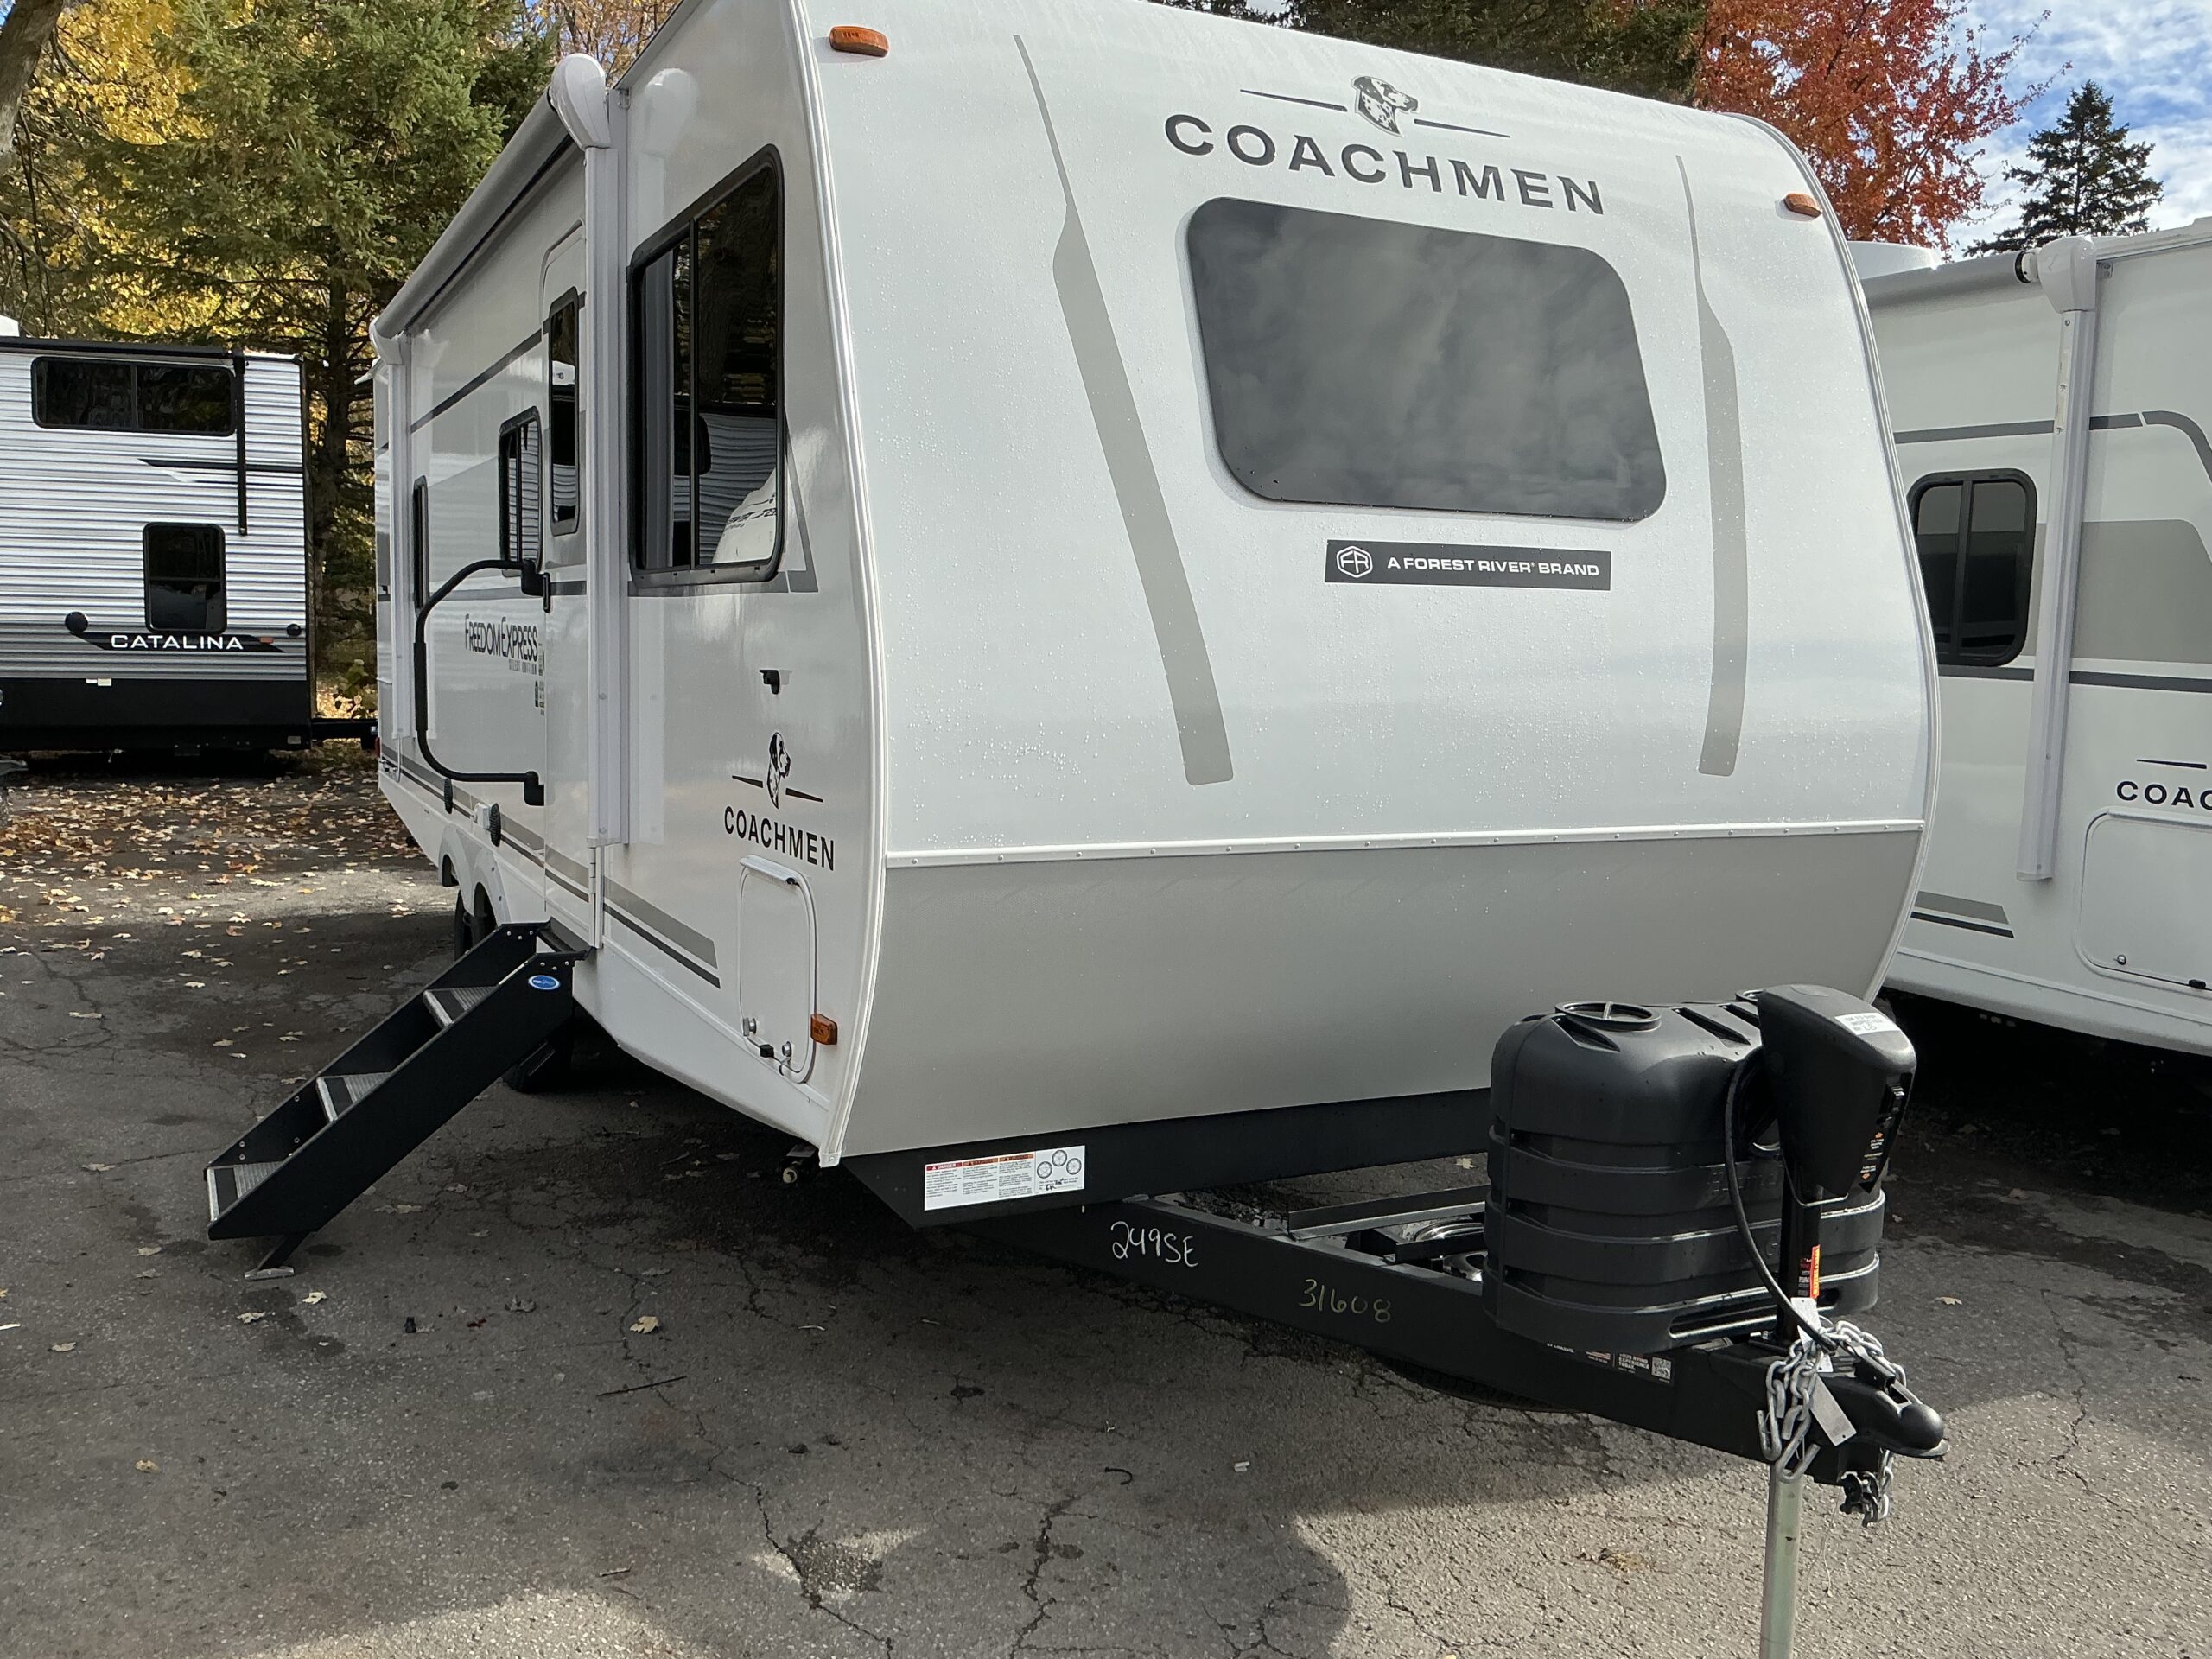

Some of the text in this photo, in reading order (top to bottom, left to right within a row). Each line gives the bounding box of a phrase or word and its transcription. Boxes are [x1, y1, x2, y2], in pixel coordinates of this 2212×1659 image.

[1164, 114, 1605, 215] COACHMEN
[1387, 556, 1402, 570] A
[1403, 557, 1475, 572] FOREST
[1538, 563, 1599, 576] BRAND
[111, 634, 244, 650] CATALINA
[724, 806, 835, 871] COACHMEN
[1110, 1221, 1198, 1268] 249SE
[1298, 1278, 1391, 1323] 31608
